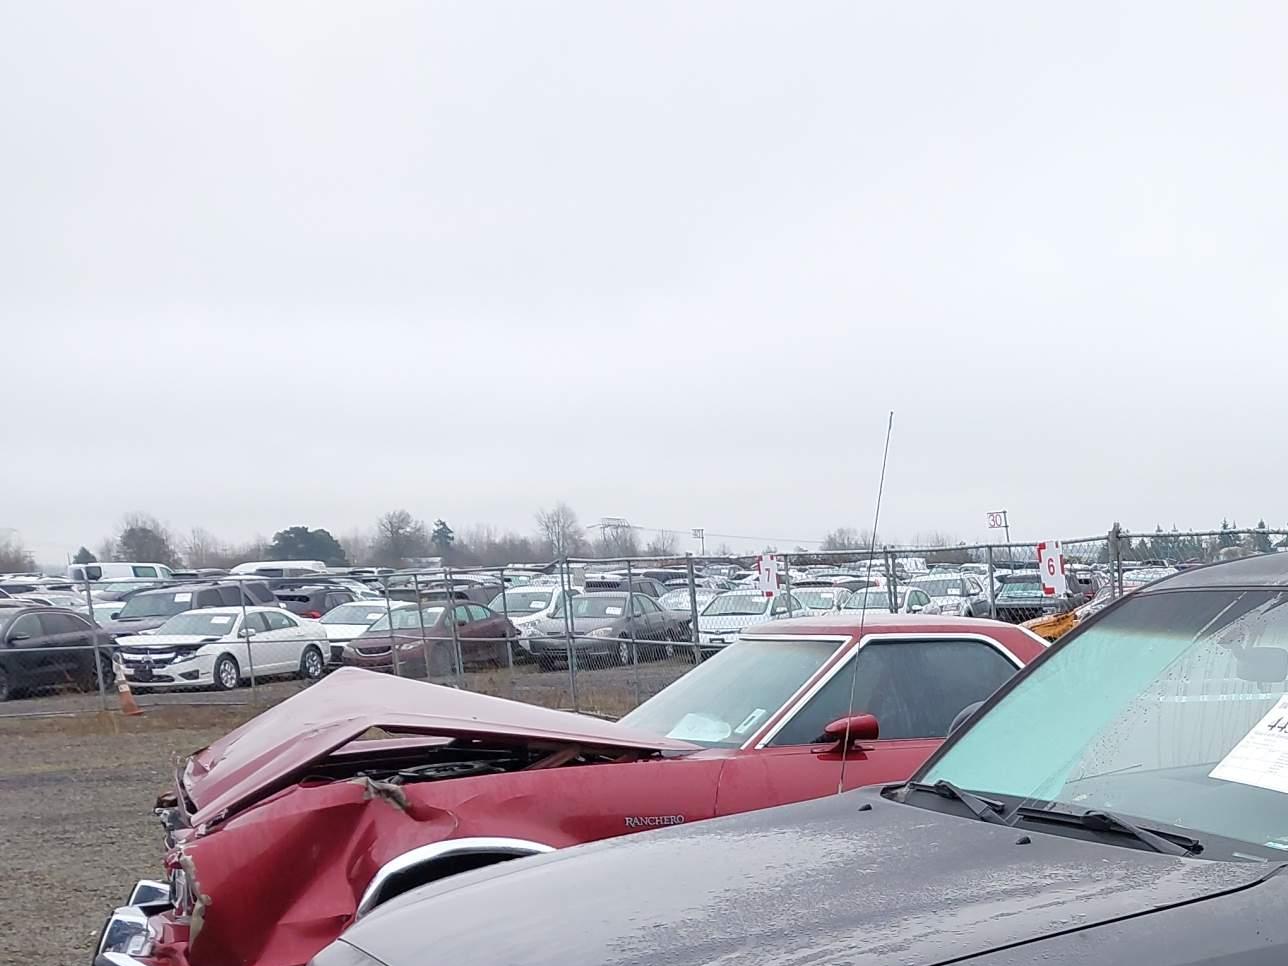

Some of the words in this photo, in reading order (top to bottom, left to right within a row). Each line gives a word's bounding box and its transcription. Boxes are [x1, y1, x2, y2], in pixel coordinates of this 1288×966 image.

[988, 513, 1002, 528] 30
[1047, 558, 1056, 576] 6
[765, 568, 770, 582] 7
[625, 815, 685, 827] RANCHERO
